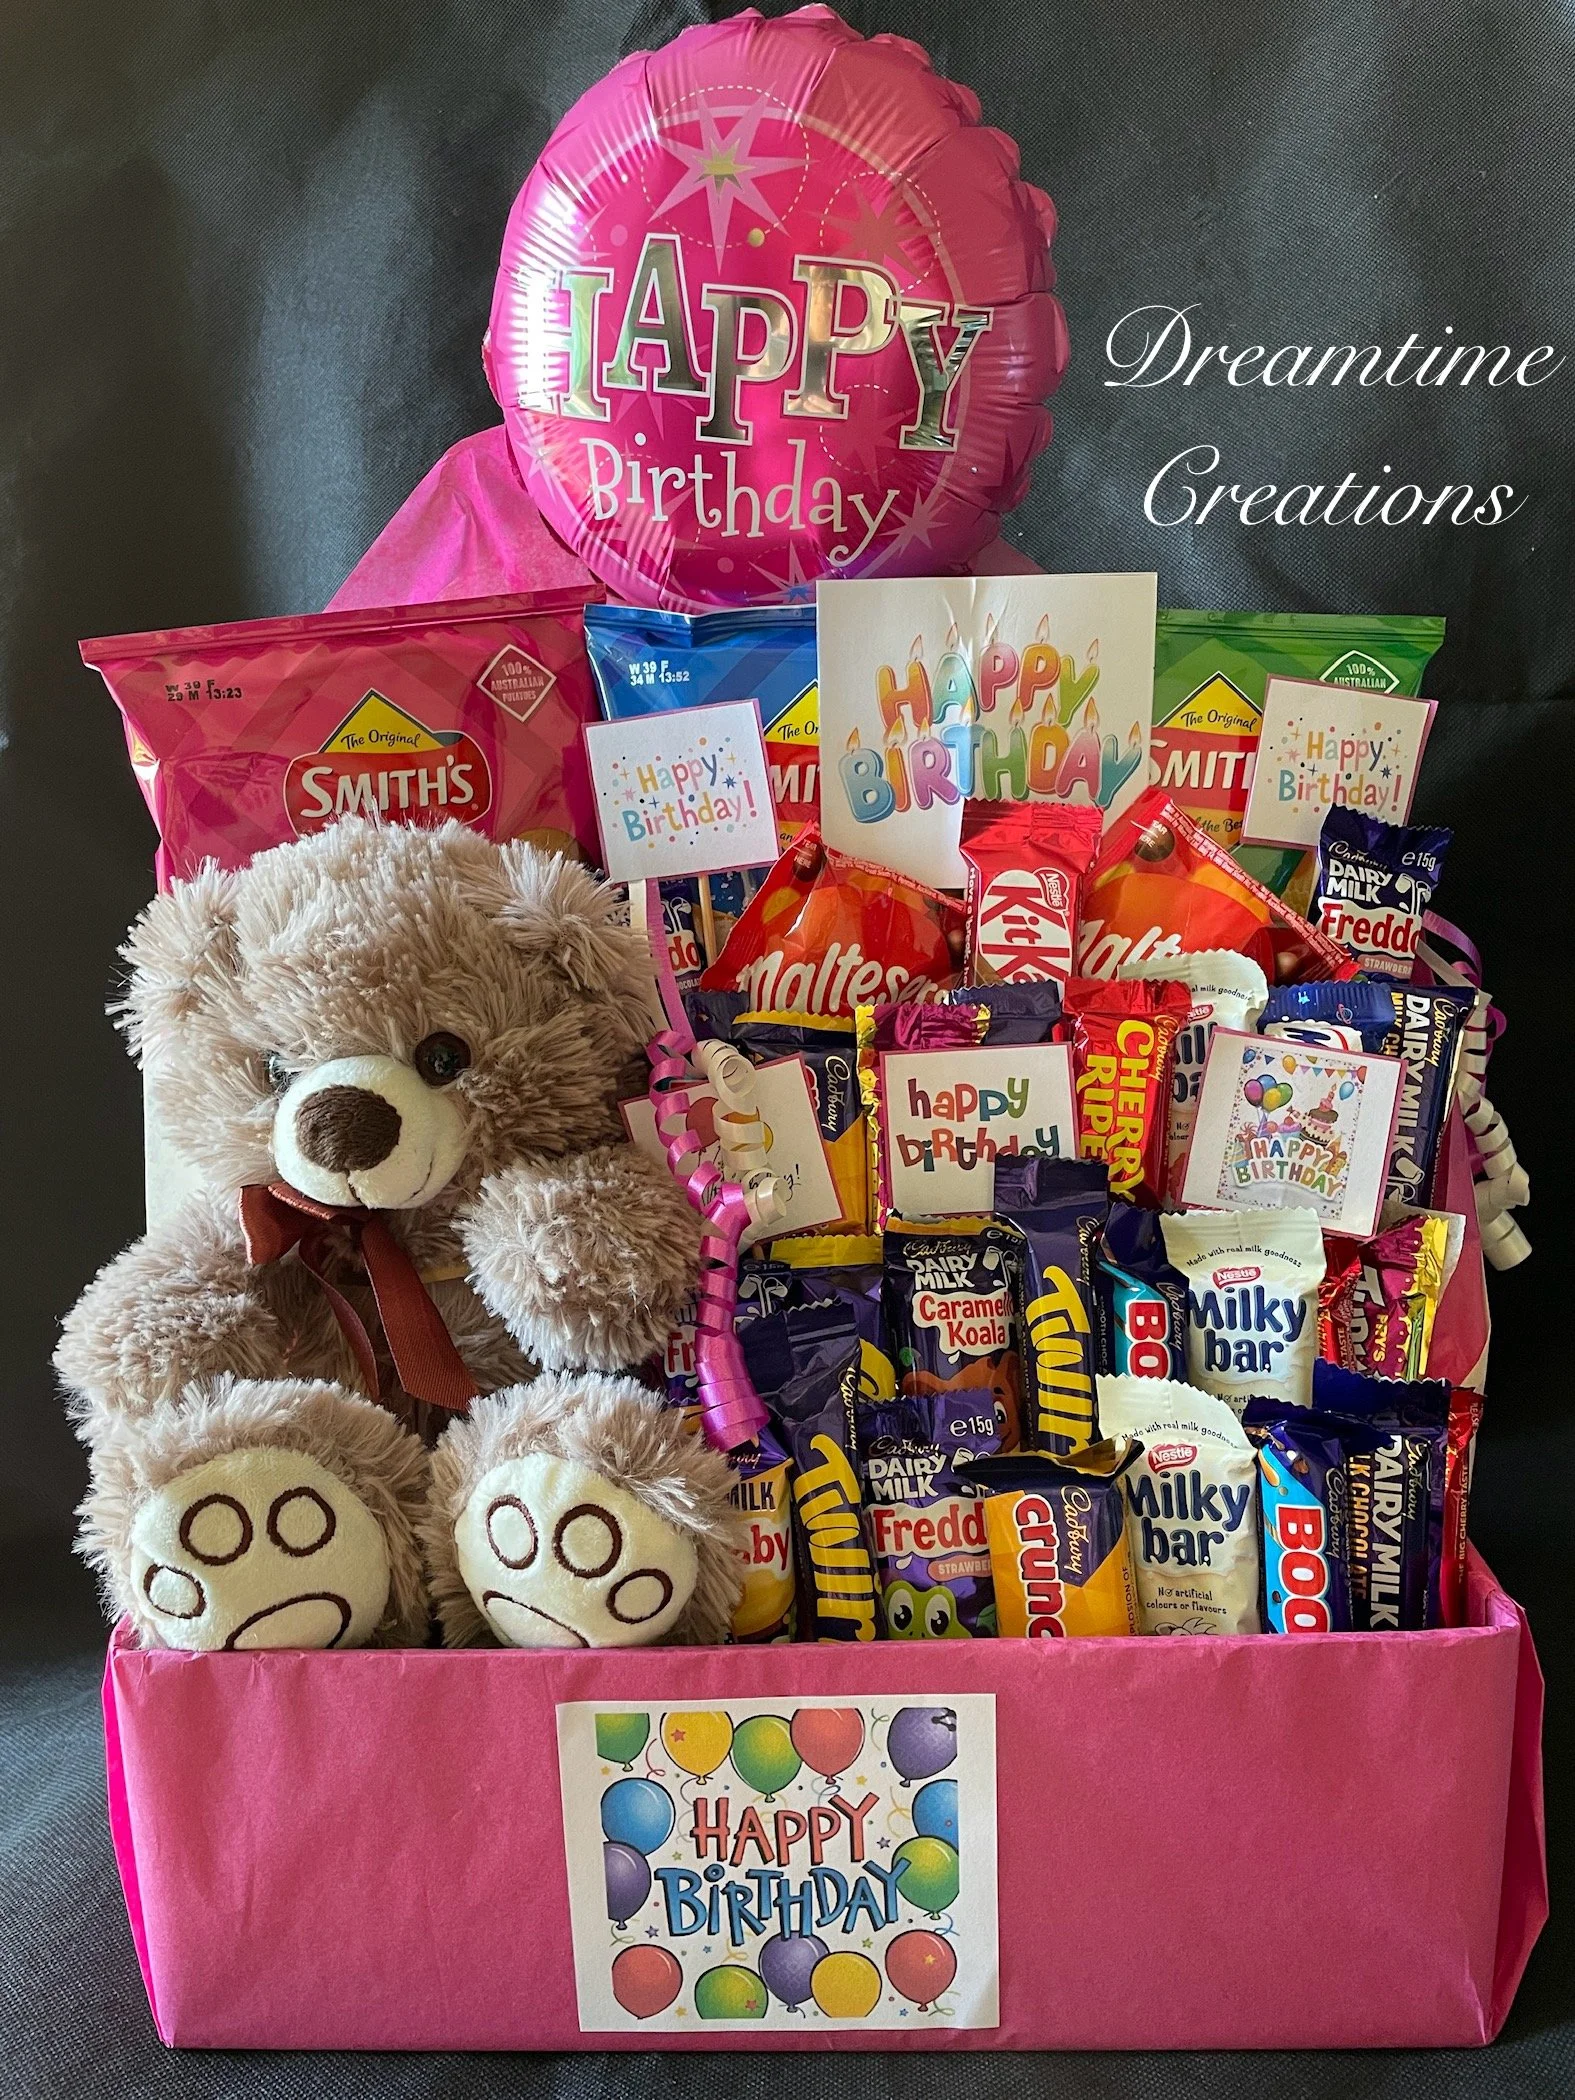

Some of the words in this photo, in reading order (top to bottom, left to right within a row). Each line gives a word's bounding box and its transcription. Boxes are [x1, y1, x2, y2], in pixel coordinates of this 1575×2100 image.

[516, 233, 994, 452] HAPPY
[580, 432, 900, 567] Birthday
[628, 663, 641, 675] W
[642, 662, 657, 674] 39
[660, 660, 669, 672] F
[630, 675, 643, 686] 34
[646, 673, 655, 685] M
[659, 671, 690, 684] 13:52
[875, 643, 1100, 729] HAPPY
[1333, 677, 1386, 688] AUSTRALIAN
[1346, 663, 1376, 677] 100%
[340, 732, 365, 750] The
[367, 729, 421, 749] Original
[778, 723, 800, 740] The
[1181, 711, 1203, 727] The
[1207, 709, 1258, 732] Original
[838, 721, 1142, 824] BIRTHDAY
[1306, 731, 1385, 771] Happy
[300, 755, 475, 819] SMITH'S
[636, 754, 718, 795] Happy
[1278, 769, 1403, 812] Birthday!
[621, 780, 758, 842] Birthday!
[1326, 877, 1381, 904] MILK
[1329, 859, 1393, 887] DAIRY
[1401, 993, 1431, 1084] DAIRY
[820, 1055, 850, 1132] Cadbury
[907, 1077, 1030, 1123] happy
[1076, 1054, 1117, 1160] RIPE
[1107, 1019, 1155, 1203] CHERRY
[1392, 1084, 1423, 1156] MILK
[1253, 1139, 1330, 1167] HAPPY
[1235, 1160, 1342, 1198] BIRTHDAY
[906, 1253, 978, 1273] DAIRY
[1186, 1251, 1206, 1267] Made
[1207, 1246, 1225, 1258] with
[1225, 1246, 1242, 1255] real
[1244, 1244, 1262, 1253] milk
[1264, 1248, 1302, 1268] goodness
[915, 1271, 976, 1291] MILK
[919, 1292, 1014, 1321] Caramello
[1155, 1282, 1189, 1352] Cadbury
[1188, 1285, 1307, 1339] Milky
[946, 1321, 1007, 1347] Koala
[1203, 1328, 1283, 1373] bar
[1025, 1265, 1091, 1454] Twirl
[1145, 1424, 1162, 1435] with
[1163, 1421, 1179, 1431] real
[1181, 1421, 1199, 1433] milk
[868, 1453, 947, 1479] DAIRY
[872, 1475, 938, 1501] MILK
[1125, 1470, 1250, 1532] Milky
[1371, 1434, 1403, 1543] DAIRY
[1061, 1485, 1092, 1574] Cadbury
[1325, 1467, 1346, 1558] Cadbury
[793, 1433, 876, 1642] Twirl
[1141, 1517, 1225, 1566] bar
[1146, 1599, 1177, 1609] colours
[1180, 1602, 1189, 1610] or
[1192, 1601, 1227, 1615] flavours
[1175, 1588, 1213, 1601] artificial
[1370, 1543, 1401, 1628] MILK
[690, 1792, 880, 1867] HAPPY
